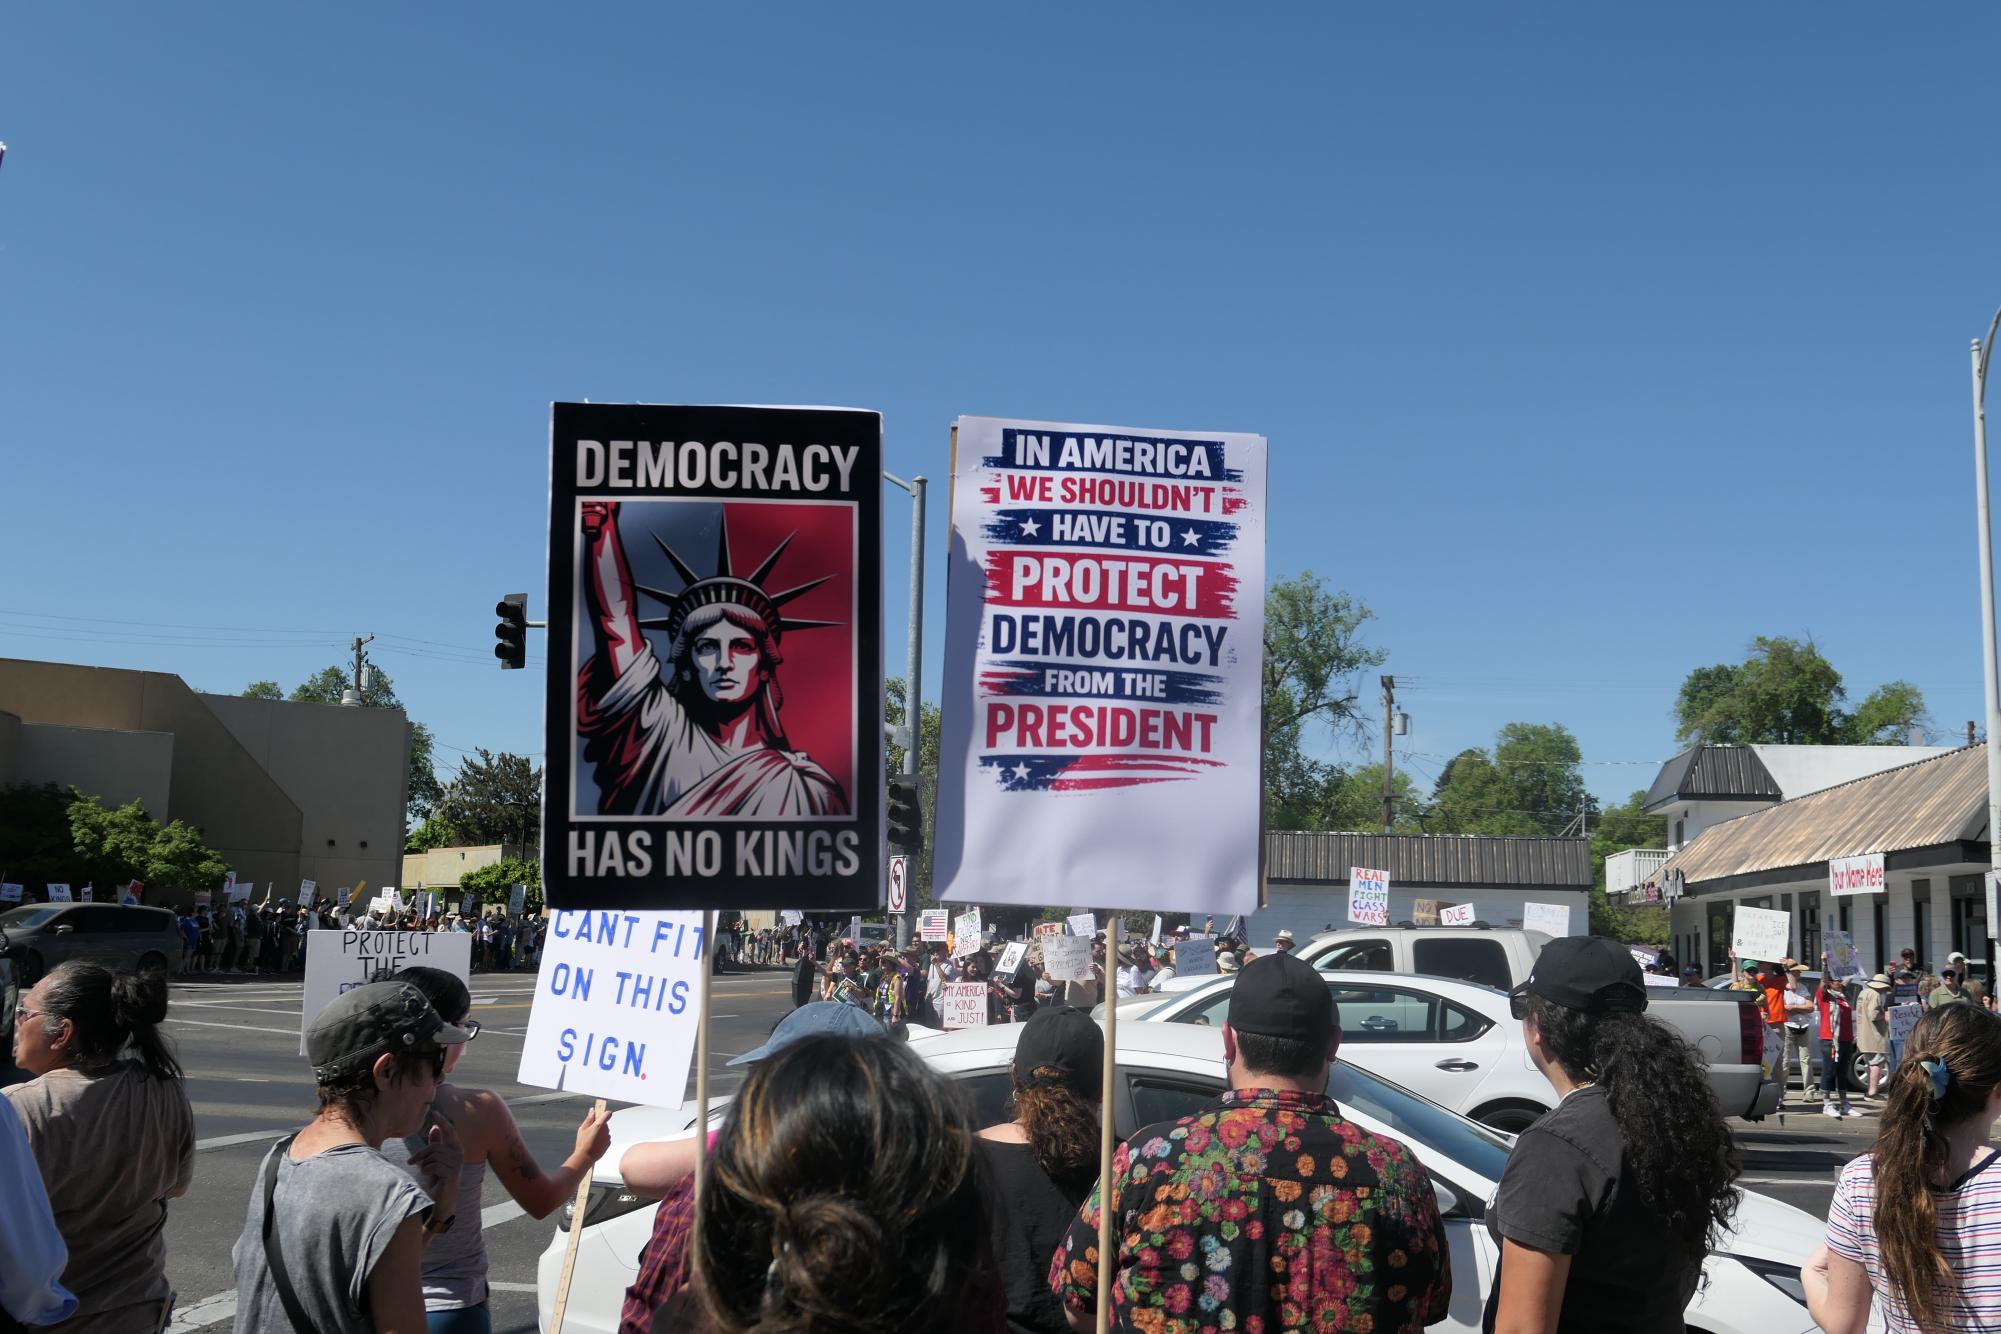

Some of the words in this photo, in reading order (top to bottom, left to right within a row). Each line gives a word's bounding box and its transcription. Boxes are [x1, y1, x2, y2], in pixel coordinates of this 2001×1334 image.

[576, 439, 860, 492] DEMOCRACY
[1015, 434, 1050, 467] IN
[1058, 437, 1212, 477] AMERICA
[1007, 475, 1054, 502] WE
[1060, 477, 1216, 513] SHOULDN'T
[1052, 514, 1126, 546] HAVE
[1134, 519, 1171, 548] TO
[1012, 556, 1204, 610] PROTECT
[991, 614, 1228, 667] DEMOCRACY
[1044, 669, 1114, 696] FROM
[1122, 672, 1167, 698] THE
[985, 702, 1218, 753] PRESIDENT
[567, 830, 652, 877] HAS
[666, 830, 721, 877] NO
[736, 830, 860, 877] KINGS
[1356, 869, 1384, 882] REAL
[1359, 880, 1383, 891] MEN
[1846, 862, 1865, 888] Name
[1866, 858, 1882, 887] Here
[54, 885, 64, 894] NO
[1354, 890, 1387, 902] FIGHT
[1352, 900, 1386, 912] CLASS
[1353, 911, 1384, 924] WARS
[1446, 906, 1469, 923] DUE
[343, 931, 435, 956] PROTECT
[554, 910, 640, 948] CANT
[651, 920, 704, 960] FIT
[357, 956, 406, 980] THE
[551, 962, 594, 1002] ON
[615, 971, 690, 1015] THIS
[945, 984, 955, 997] MY
[956, 984, 986, 997] AMERICA
[955, 1000, 977, 1010] KIND
[958, 1012, 984, 1025] JUST!
[557, 1028, 647, 1081] SIGN.
